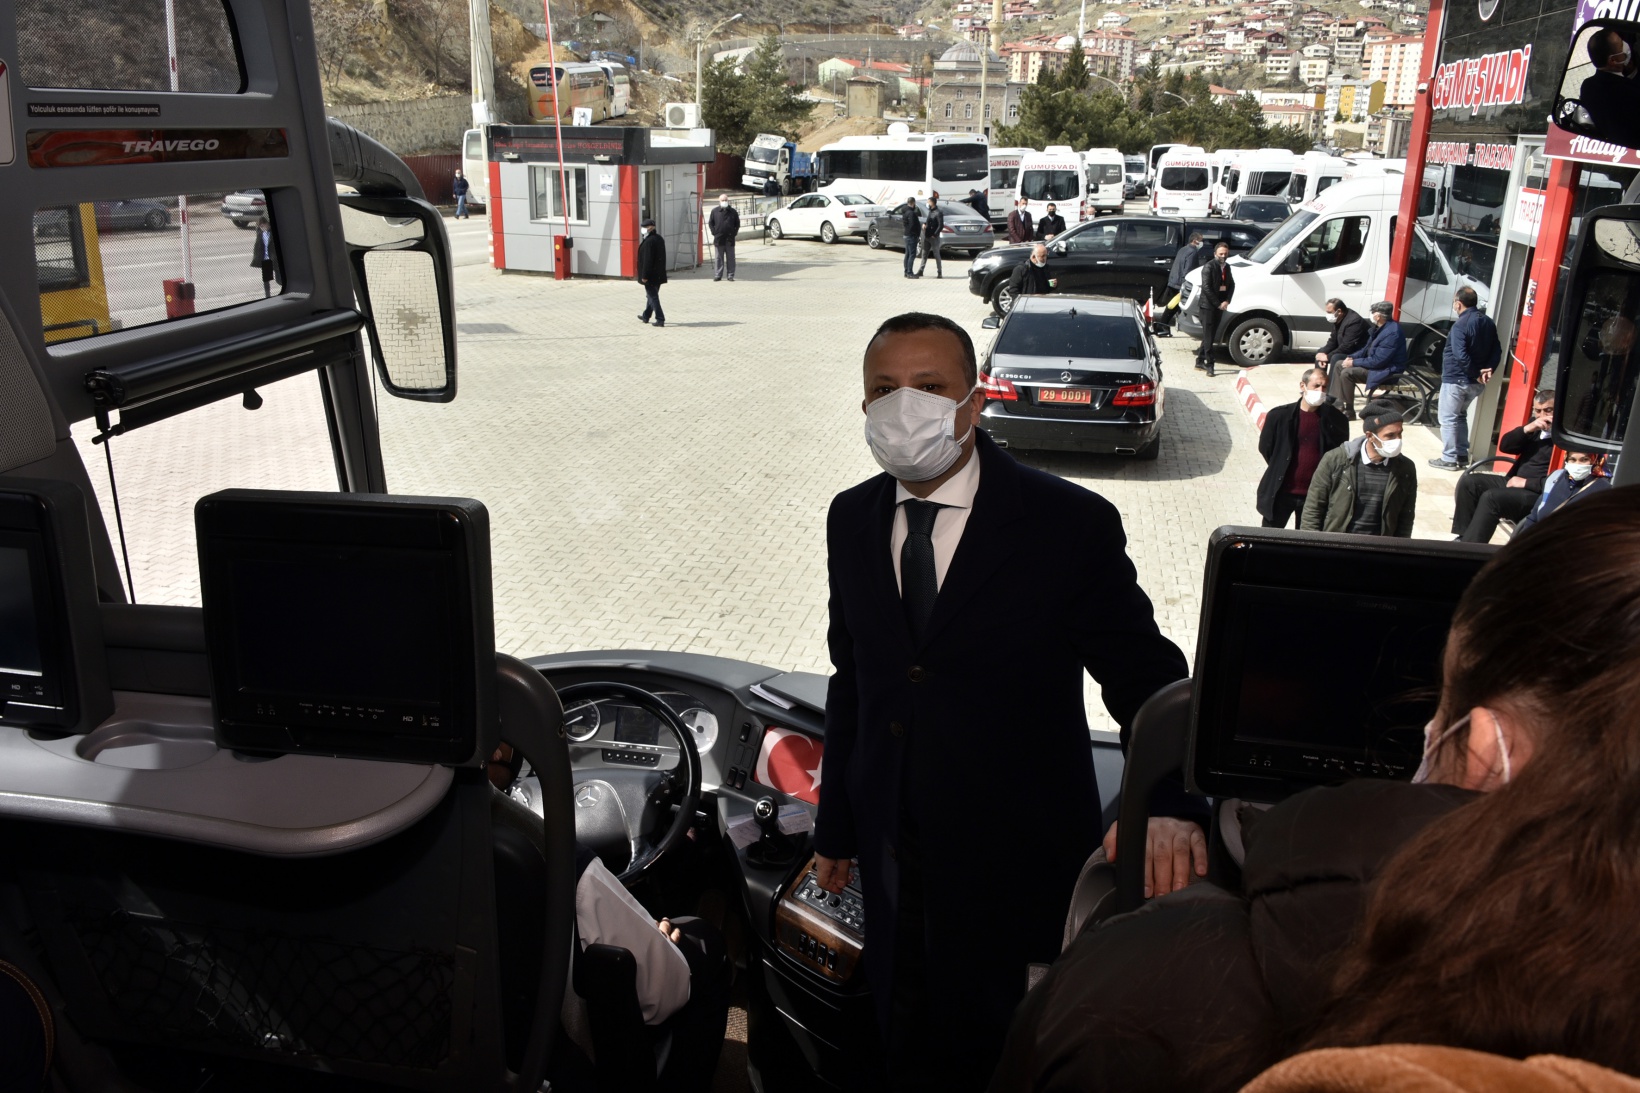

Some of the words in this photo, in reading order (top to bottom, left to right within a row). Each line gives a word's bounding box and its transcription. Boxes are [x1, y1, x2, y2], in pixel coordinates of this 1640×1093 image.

[1432, 43, 1532, 116] GÜMÜŞVADİ
[30, 104, 56, 114] Yolculuk
[122, 139, 220, 153] TRAVEGO
[1473, 142, 1517, 171] TRABZON
[1043, 389, 1056, 401] 29
[1061, 390, 1087, 402] 0001
